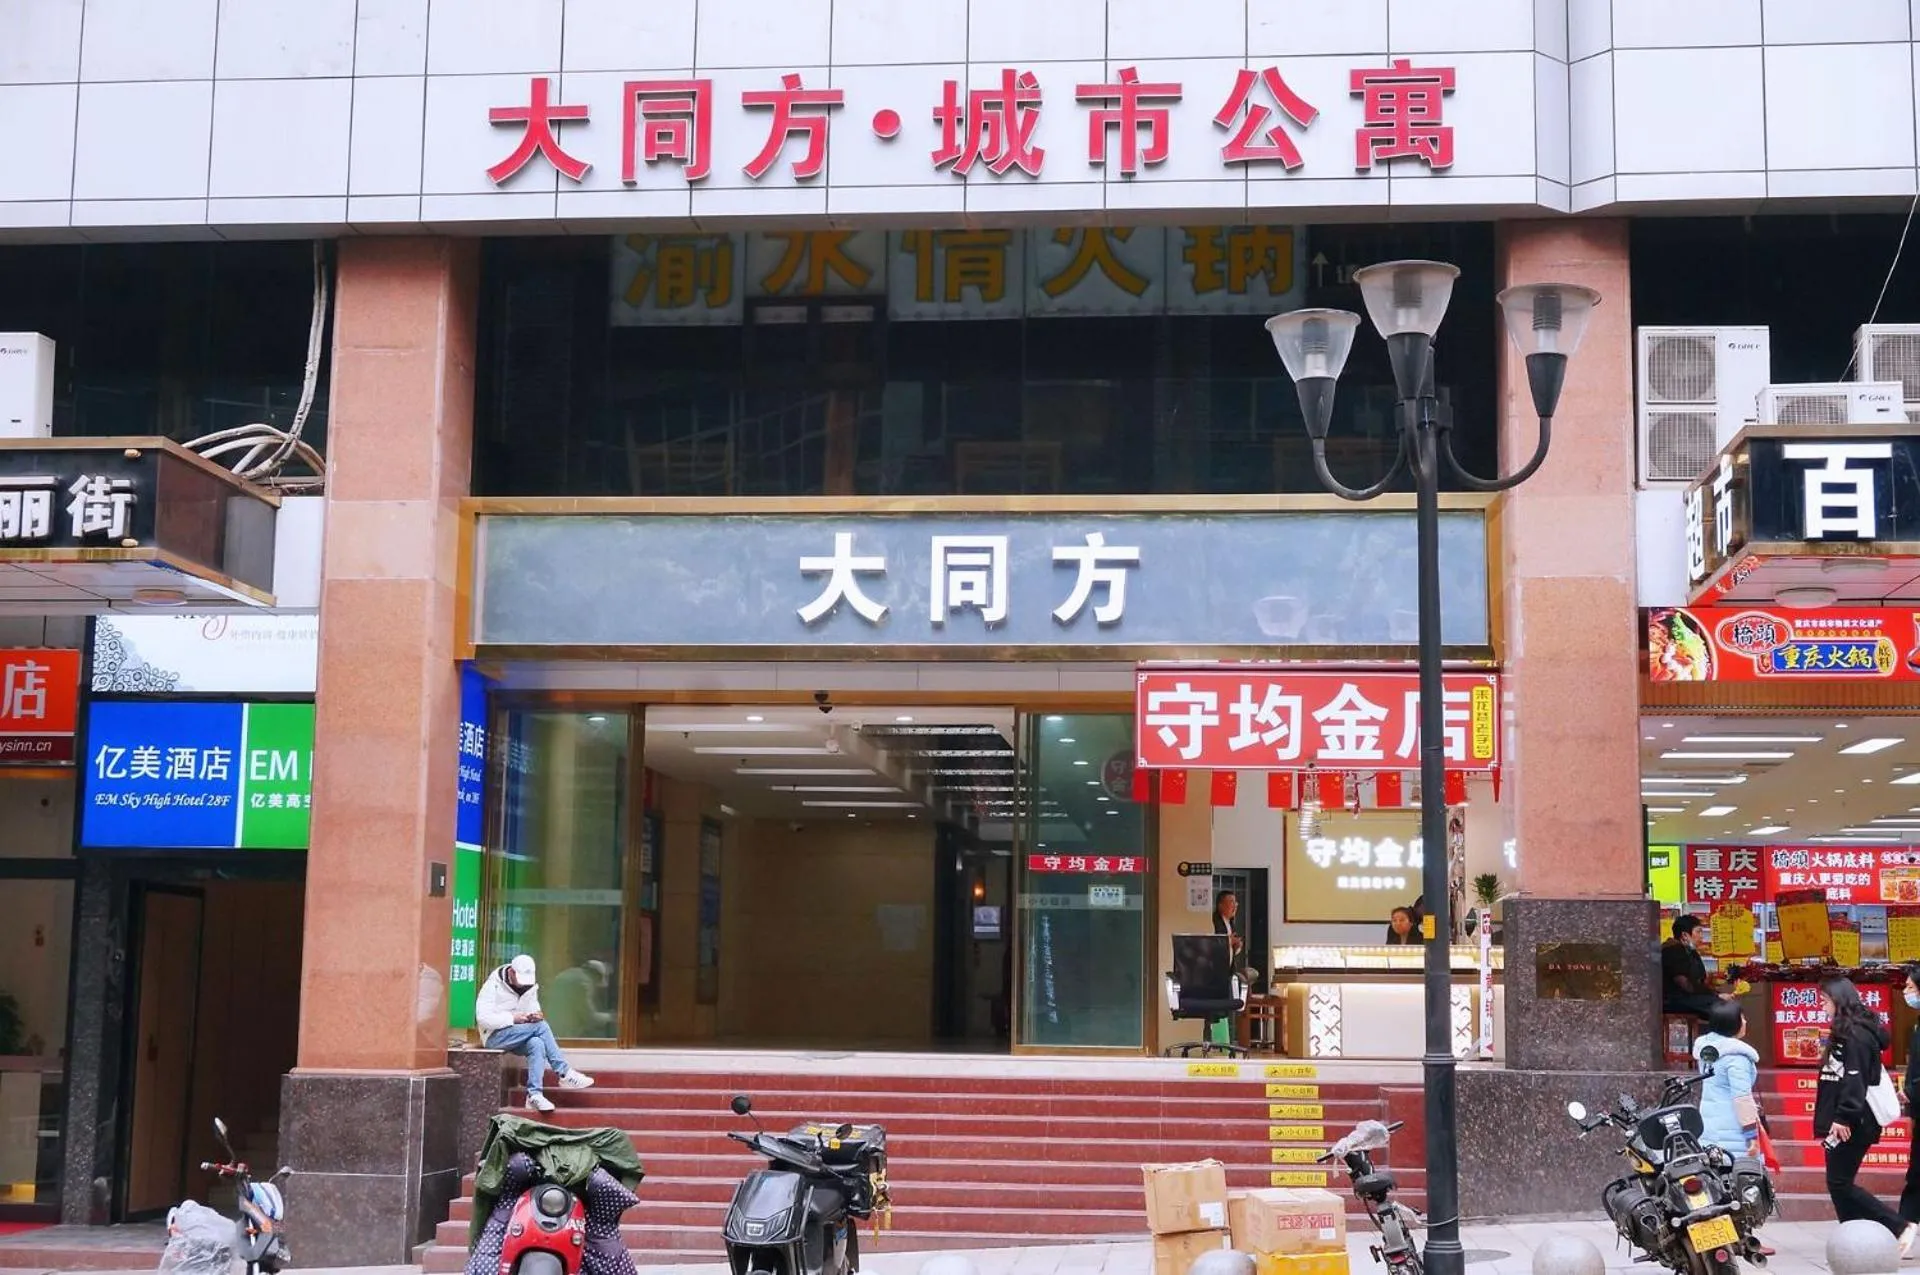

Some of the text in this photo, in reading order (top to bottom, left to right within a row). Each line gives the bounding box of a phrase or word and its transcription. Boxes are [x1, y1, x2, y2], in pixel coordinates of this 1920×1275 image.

[486, 58, 1456, 185] 大同方·城市公寓
[1782, 442, 1893, 539] 百
[796, 531, 1141, 628] 大同方
[0, 659, 51, 719] 店
[1145, 682, 1470, 761] 守均金店
[95, 744, 232, 781] 亿美酒店
[250, 749, 299, 781] EM
[95, 791, 232, 810] EM Sky High Hotel 28F
[1044, 856, 1136, 873] 守均金店
[1693, 848, 1758, 872] 重庆
[1693, 876, 1758, 899] 特产
[451, 898, 478, 928] Hotel
[450, 938, 475, 957] 空酒店
